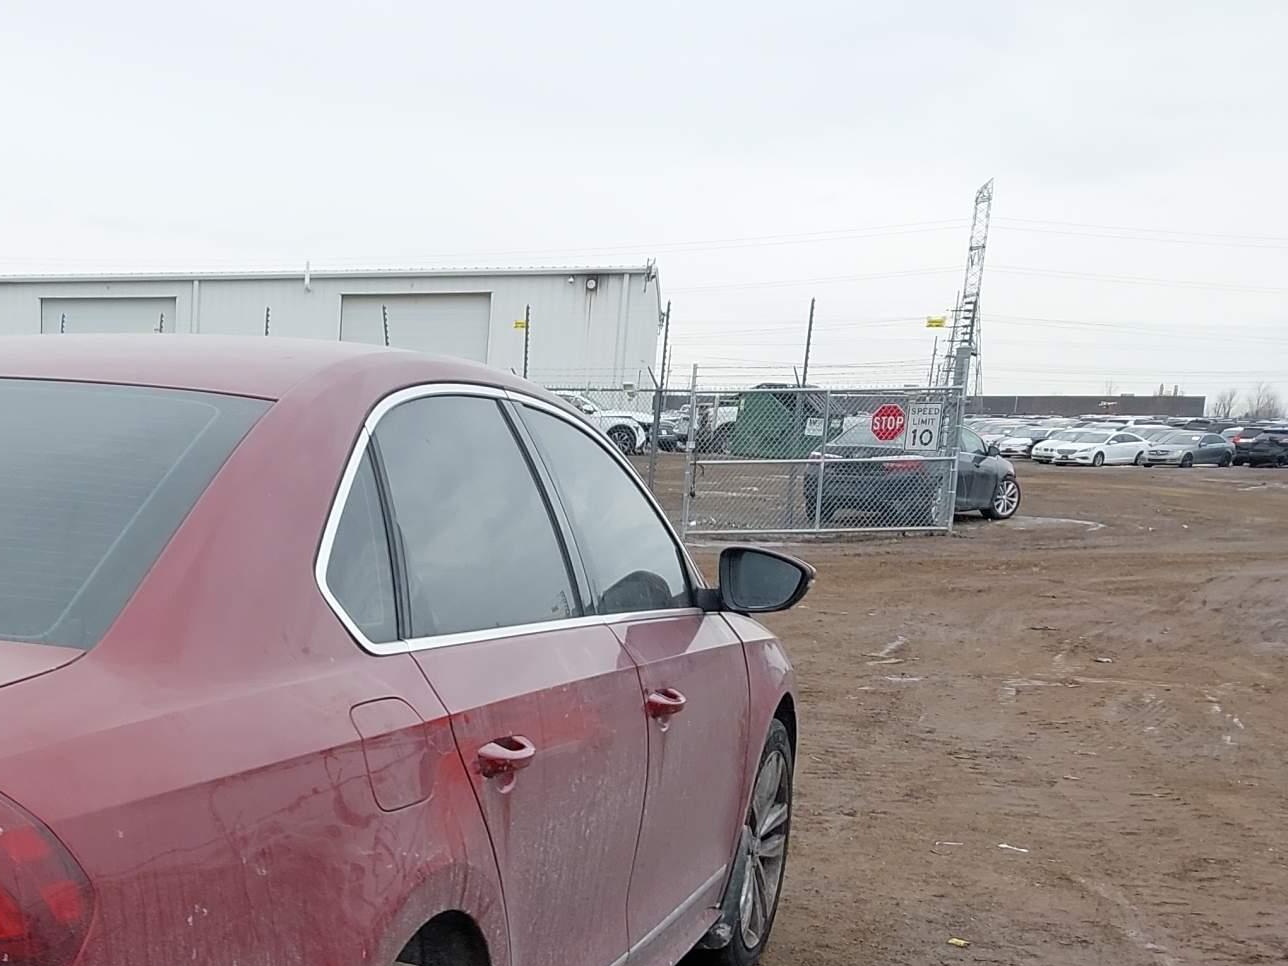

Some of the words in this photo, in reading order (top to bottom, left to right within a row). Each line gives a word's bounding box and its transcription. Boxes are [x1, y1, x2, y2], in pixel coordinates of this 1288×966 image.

[911, 408, 940, 416] SPEED
[872, 416, 904, 430] STOP
[912, 418, 936, 426] LIMIT
[911, 428, 933, 446] 10
